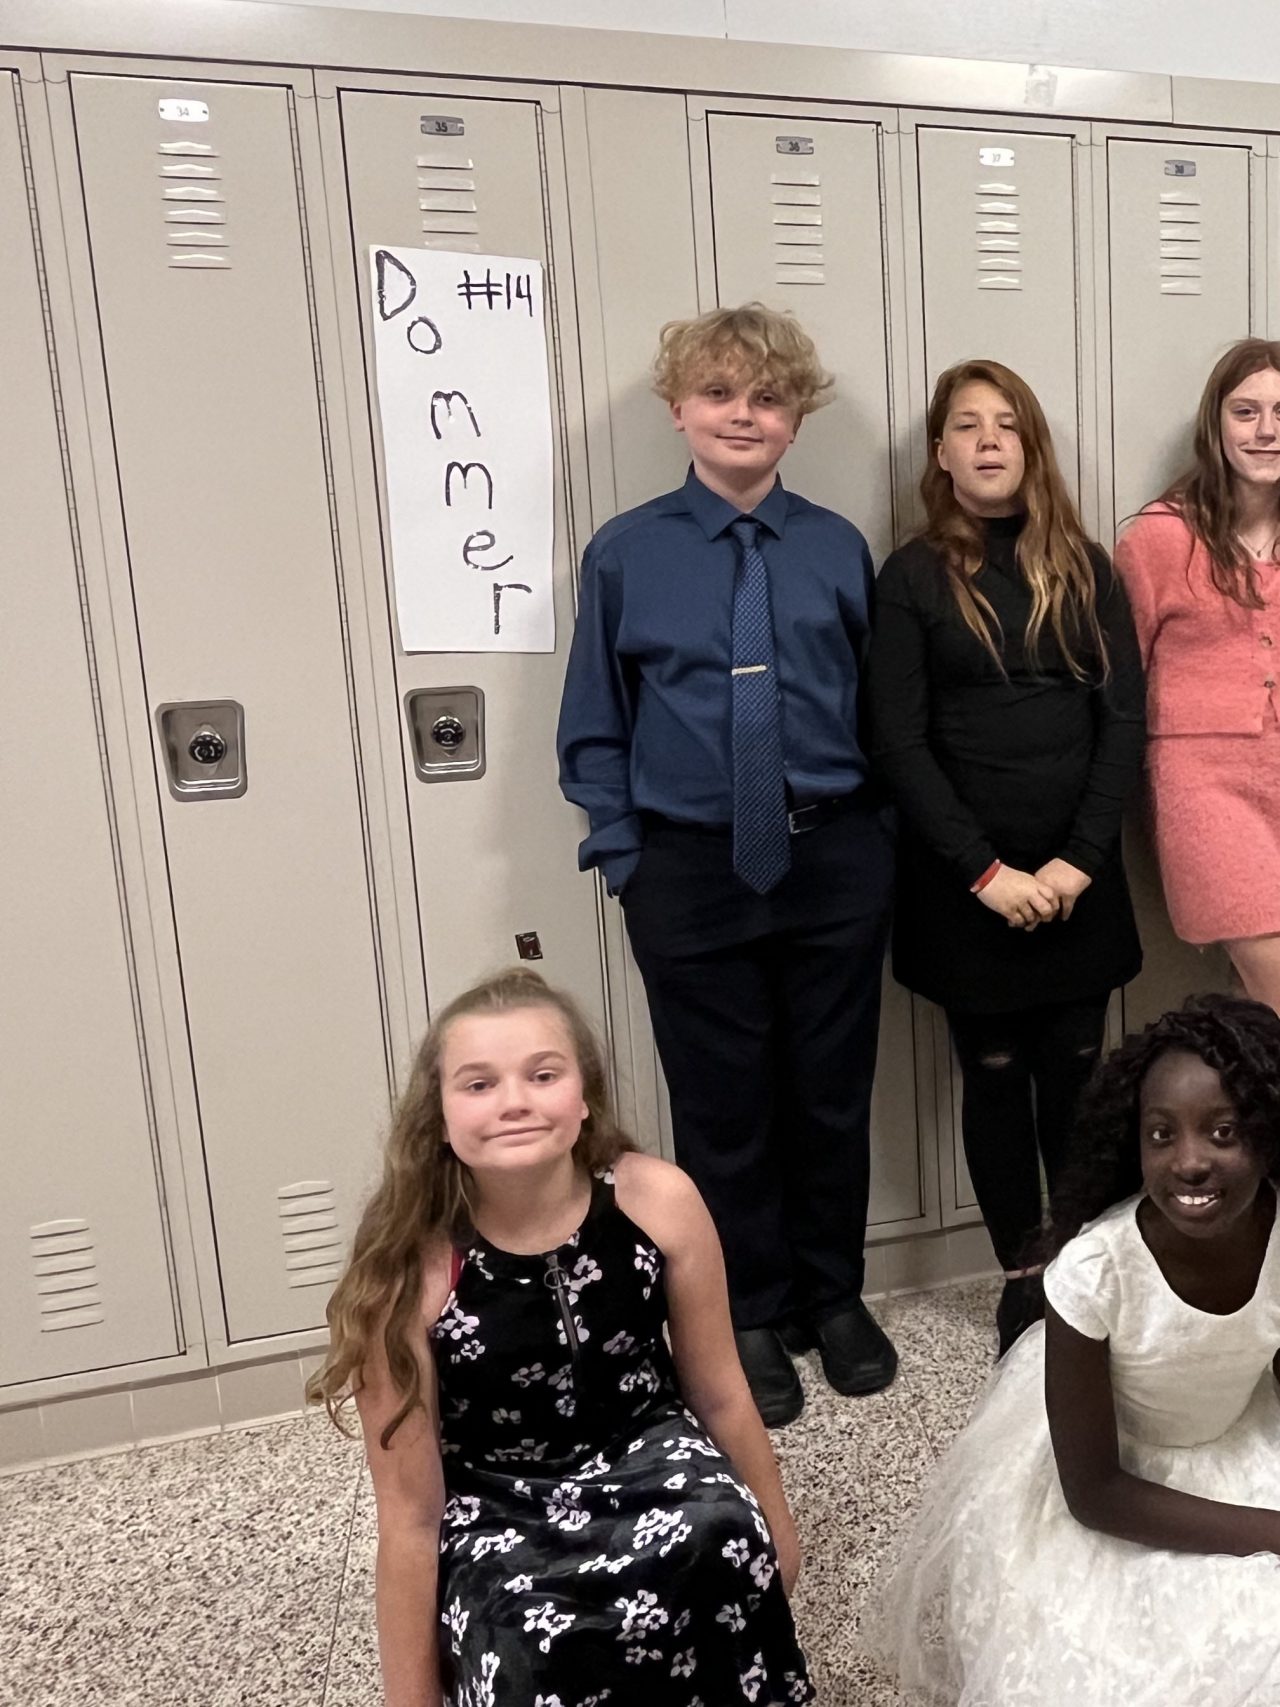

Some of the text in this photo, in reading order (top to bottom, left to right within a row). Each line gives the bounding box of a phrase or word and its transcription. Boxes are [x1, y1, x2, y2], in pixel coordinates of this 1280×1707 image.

[434, 121, 448, 133] 35
[457, 268, 534, 318] #14
[376, 250, 532, 635] Dommer
